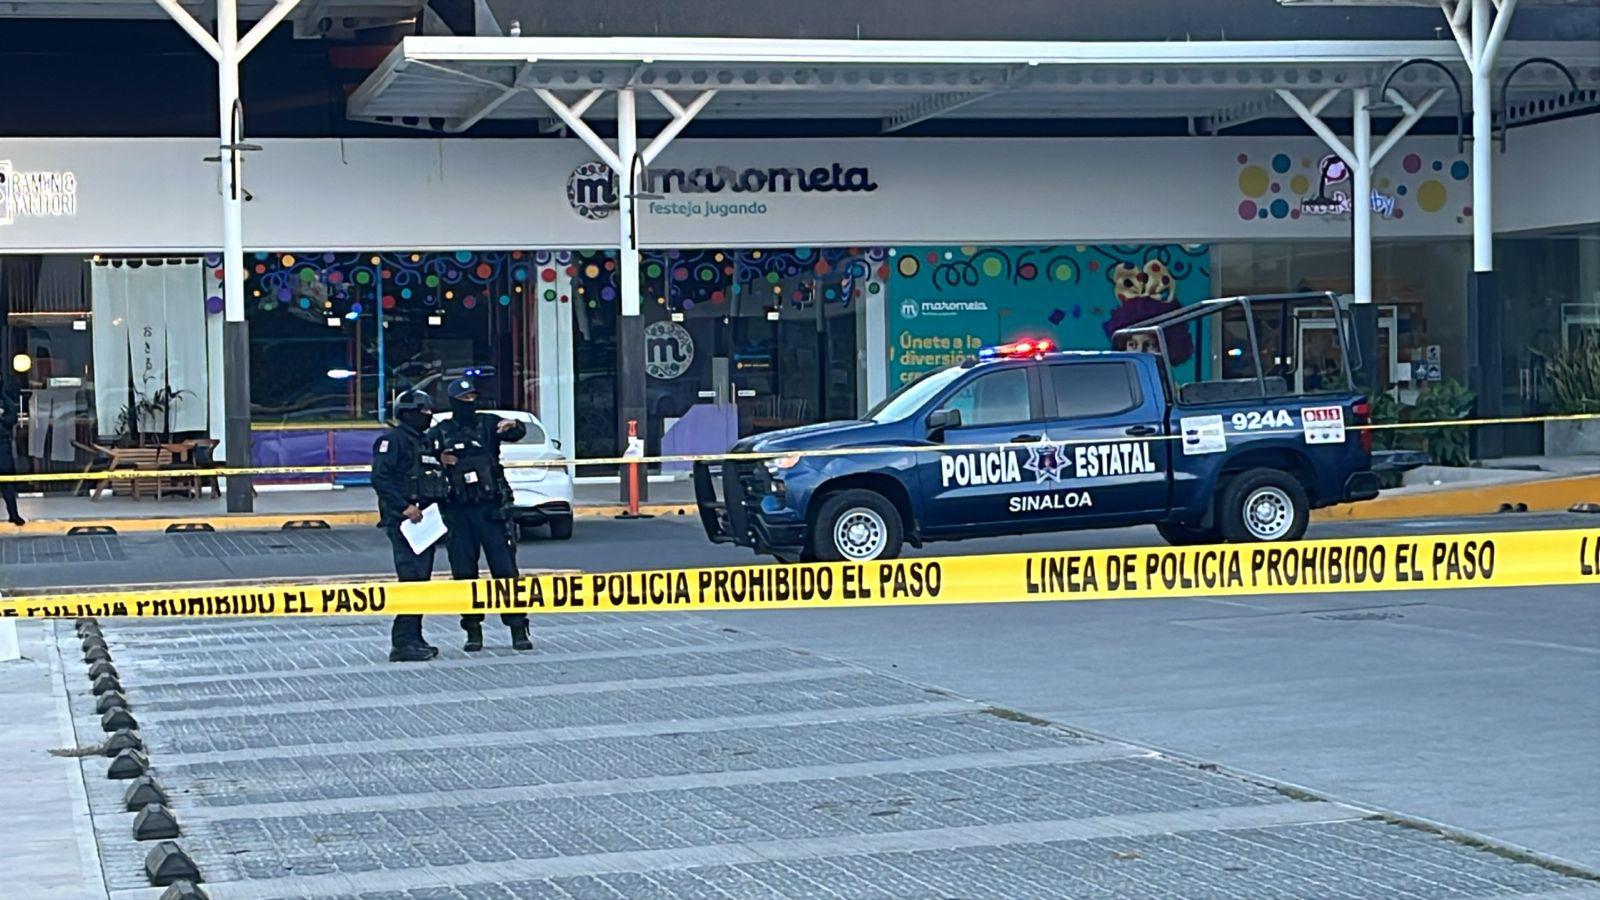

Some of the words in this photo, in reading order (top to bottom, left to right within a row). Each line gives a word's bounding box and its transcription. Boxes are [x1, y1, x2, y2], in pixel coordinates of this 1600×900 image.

[648, 163, 877, 193] marometa
[649, 201, 700, 218] festeja
[704, 201, 767, 218] jugando
[1231, 409, 1294, 431] 924A
[941, 446, 1021, 487] POLICÍA
[1074, 441, 1155, 478] ESTATAL
[1009, 492, 1092, 512] SINALOA
[1026, 556, 1098, 594] LINEA
[1106, 554, 1137, 591] DE
[1146, 550, 1242, 590] POLICIA
[1251, 544, 1386, 586] PROHIBIDO
[1395, 545, 1424, 582] EL
[1432, 540, 1495, 580] PASO
[471, 576, 545, 608] LINEA
[552, 576, 584, 606] DE
[593, 572, 691, 606] POLICIA
[699, 566, 833, 602] PROHIBIDO
[842, 565, 871, 599] EL
[880, 561, 941, 597] PASO
[283, 591, 314, 613] EL
[321, 587, 386, 612] PASO
